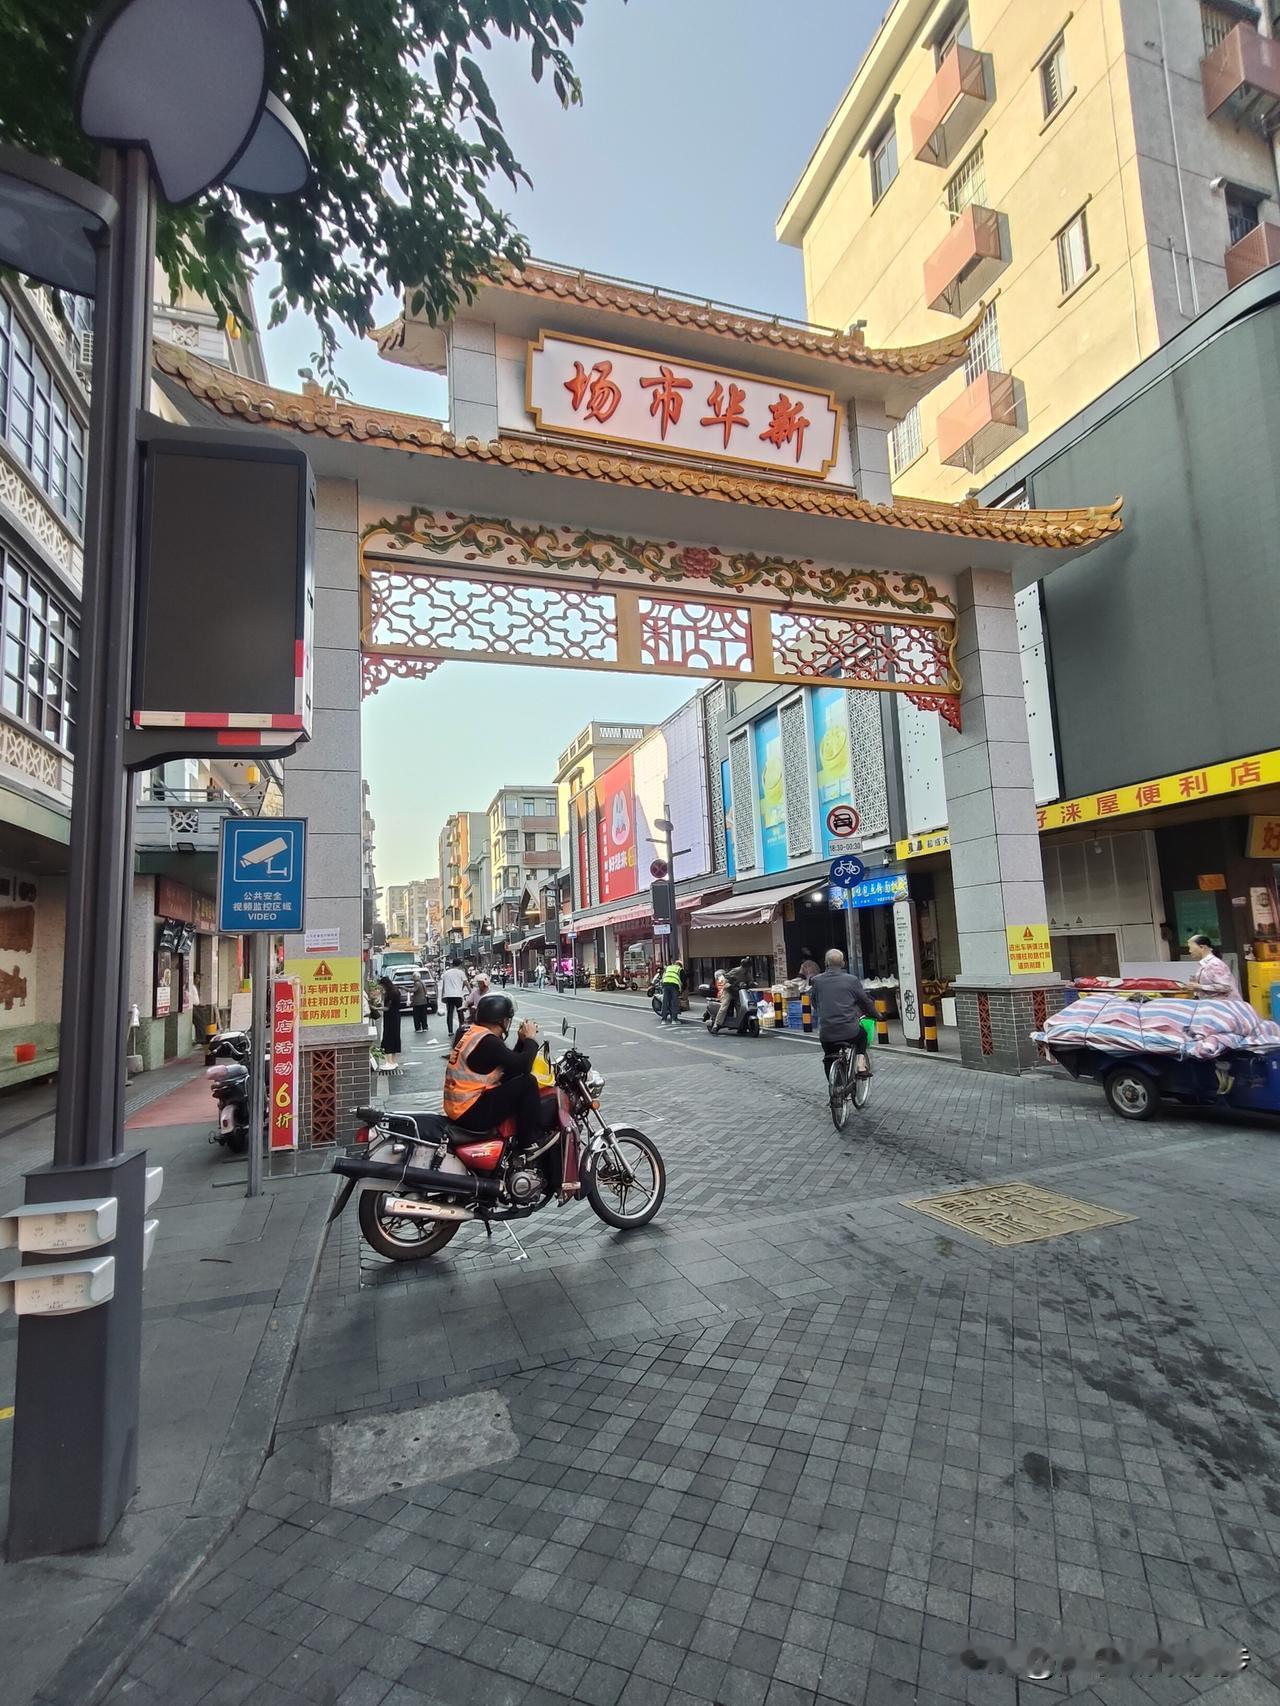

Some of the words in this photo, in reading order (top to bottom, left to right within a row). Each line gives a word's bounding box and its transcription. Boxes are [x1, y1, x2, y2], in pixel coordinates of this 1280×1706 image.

[243, 891, 283, 901] 公共安全
[233, 902, 292, 911] 视频监控区域
[274, 999, 294, 1129] 新店活动6折
